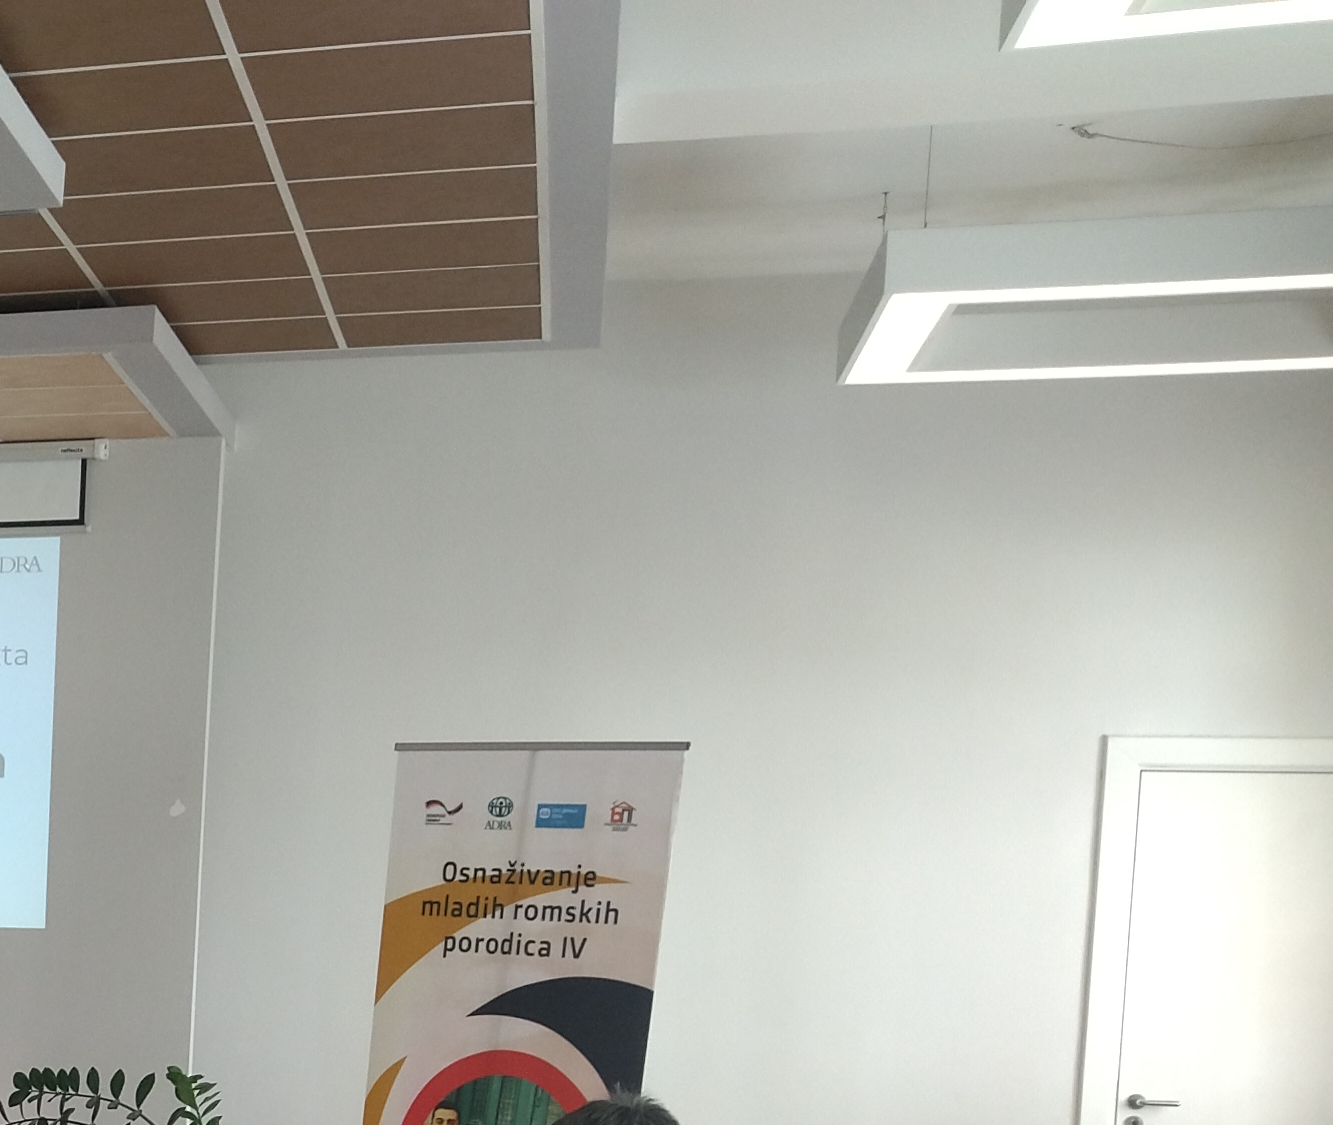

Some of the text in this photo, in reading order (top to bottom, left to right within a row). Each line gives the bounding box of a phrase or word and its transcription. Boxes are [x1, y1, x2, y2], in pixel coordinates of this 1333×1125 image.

[484, 820, 513, 831] ADRA
[442, 860, 597, 894] Osnaživanje
[421, 894, 620, 925] mladih romskih
[442, 932, 588, 959] porodica IV
